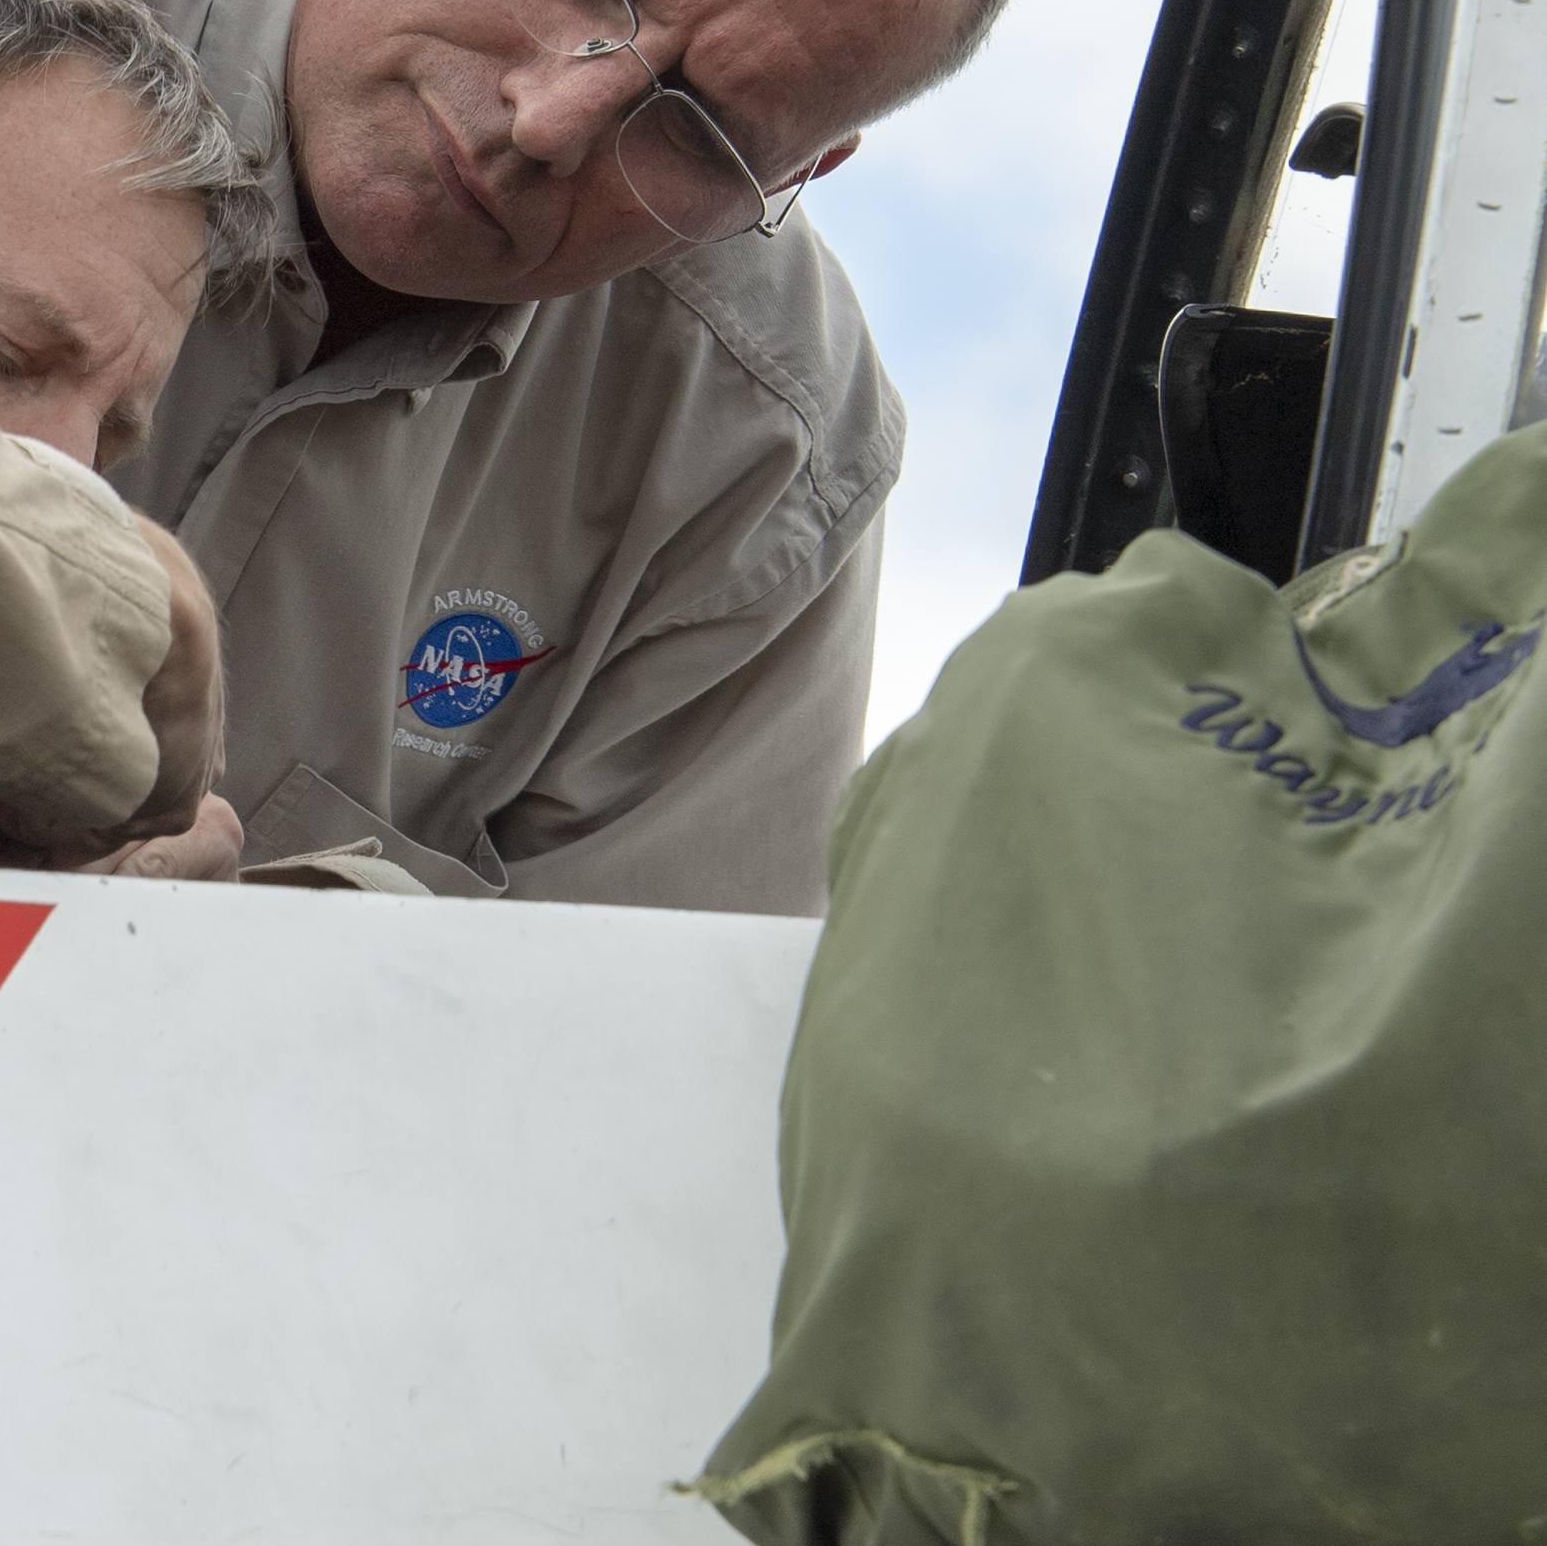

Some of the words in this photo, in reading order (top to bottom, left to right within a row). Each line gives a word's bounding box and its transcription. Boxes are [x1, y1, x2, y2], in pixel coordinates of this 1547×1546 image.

[433, 588, 545, 650] ARMSTRONG
[417, 644, 507, 697] NASA
[391, 728, 452, 758] Research
